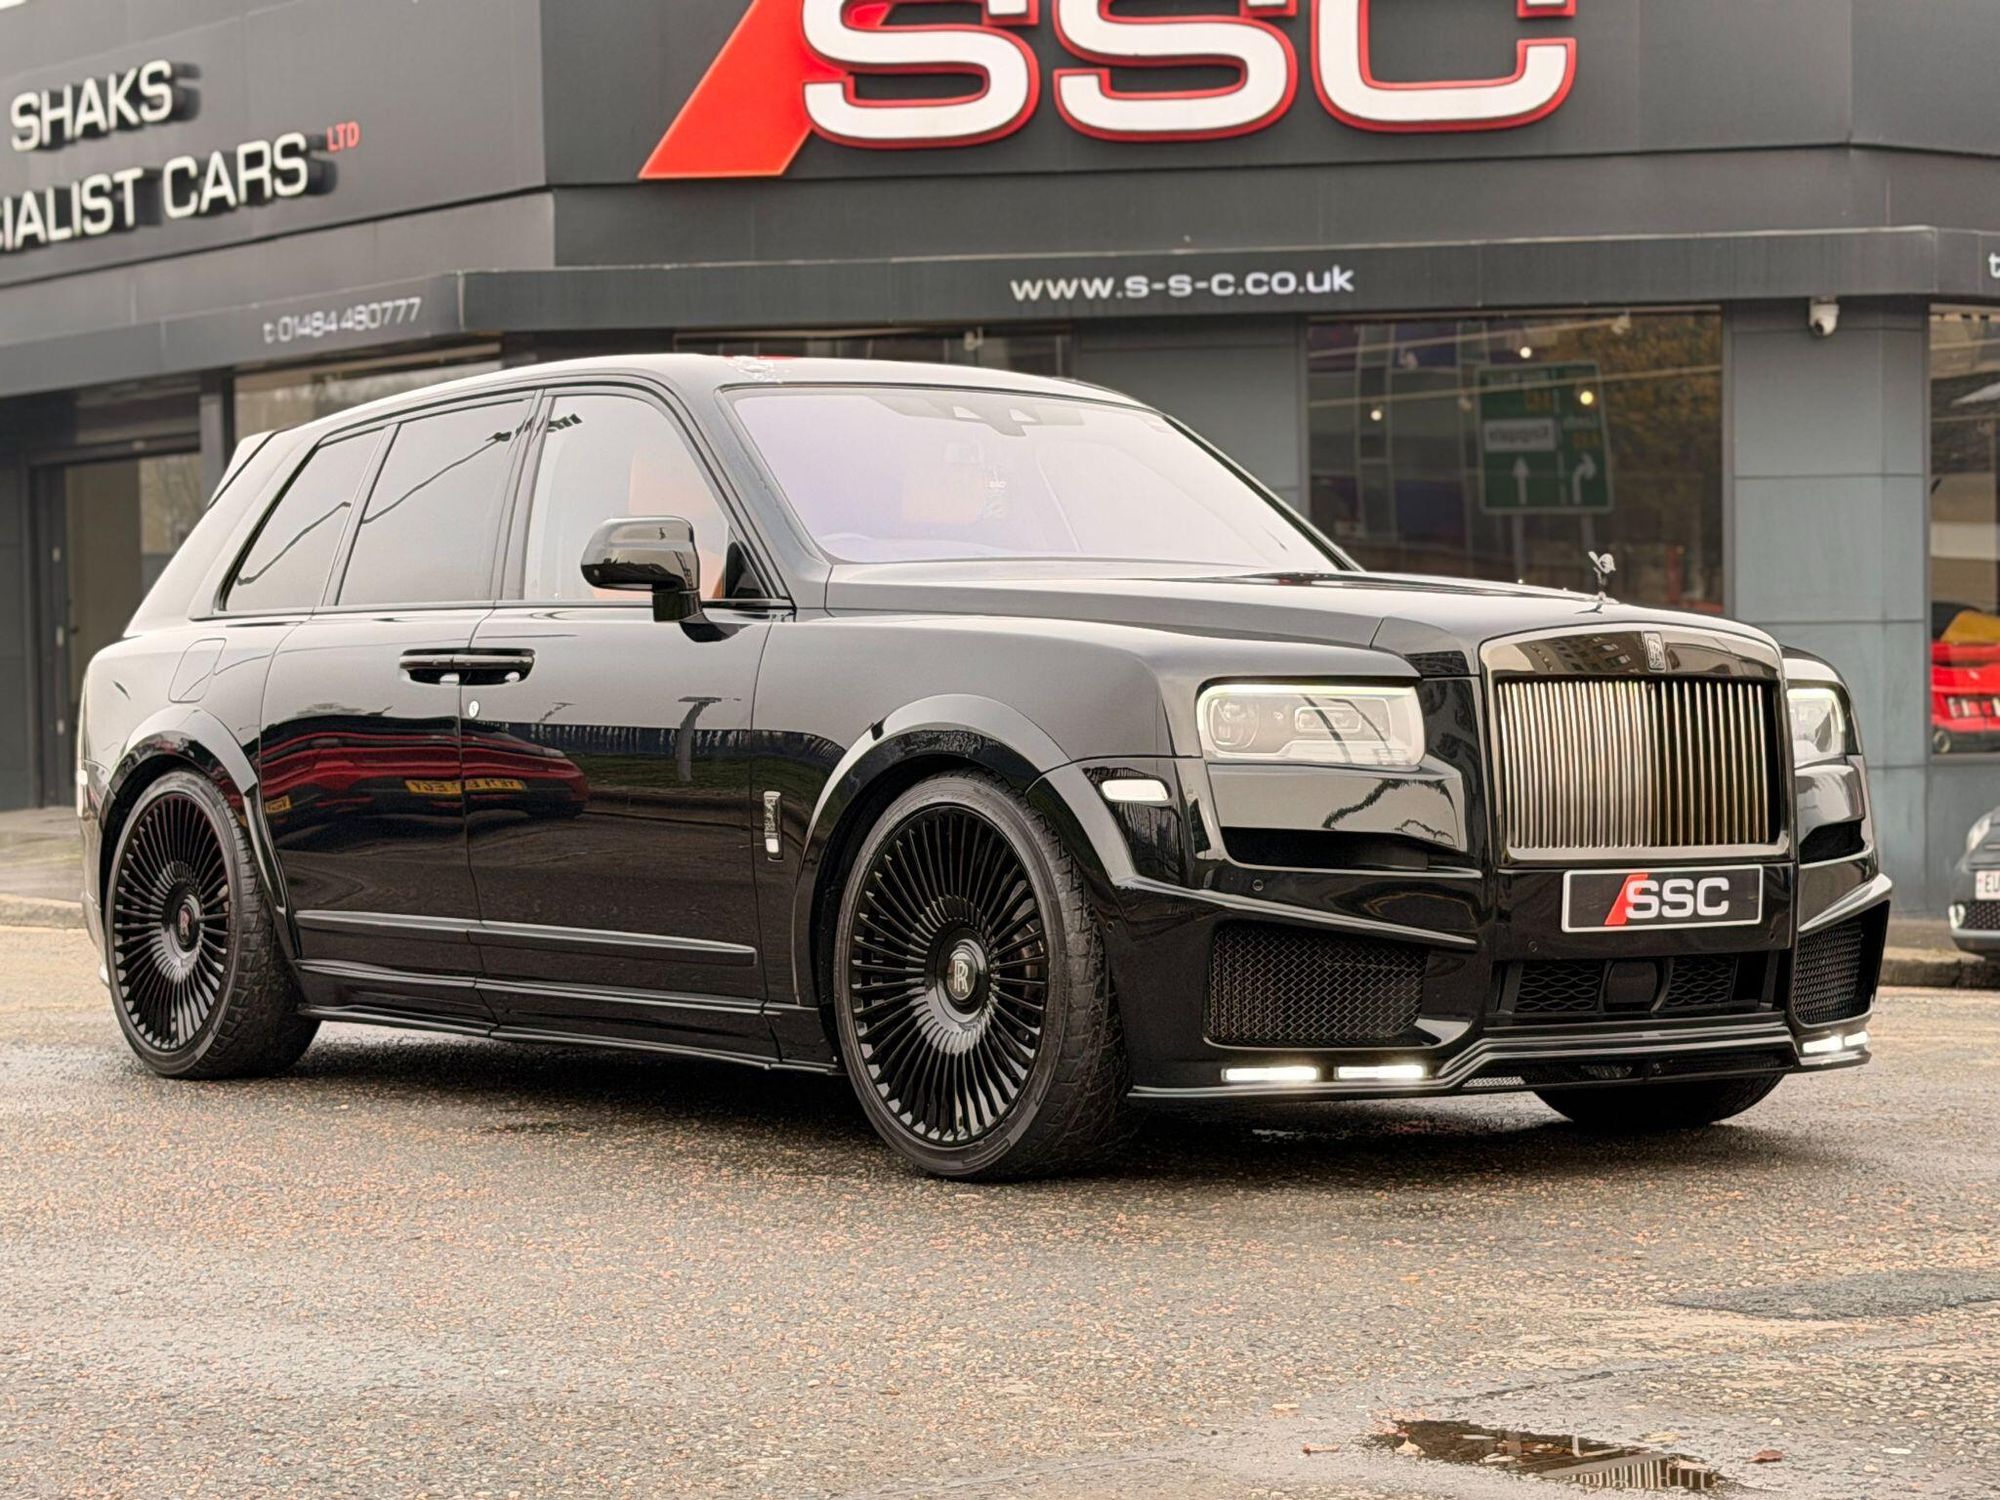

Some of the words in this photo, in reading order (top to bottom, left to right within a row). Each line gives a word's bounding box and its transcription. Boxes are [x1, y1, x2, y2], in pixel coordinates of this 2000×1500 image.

[10, 59, 173, 151] SHAKS
[802, 0, 1579, 147] SSC
[163, 131, 308, 219] CARS
[326, 121, 361, 153] LTD
[1010, 265, 1355, 301] www.s-s-c.co.uk
[1624, 876, 1730, 920] SSC
